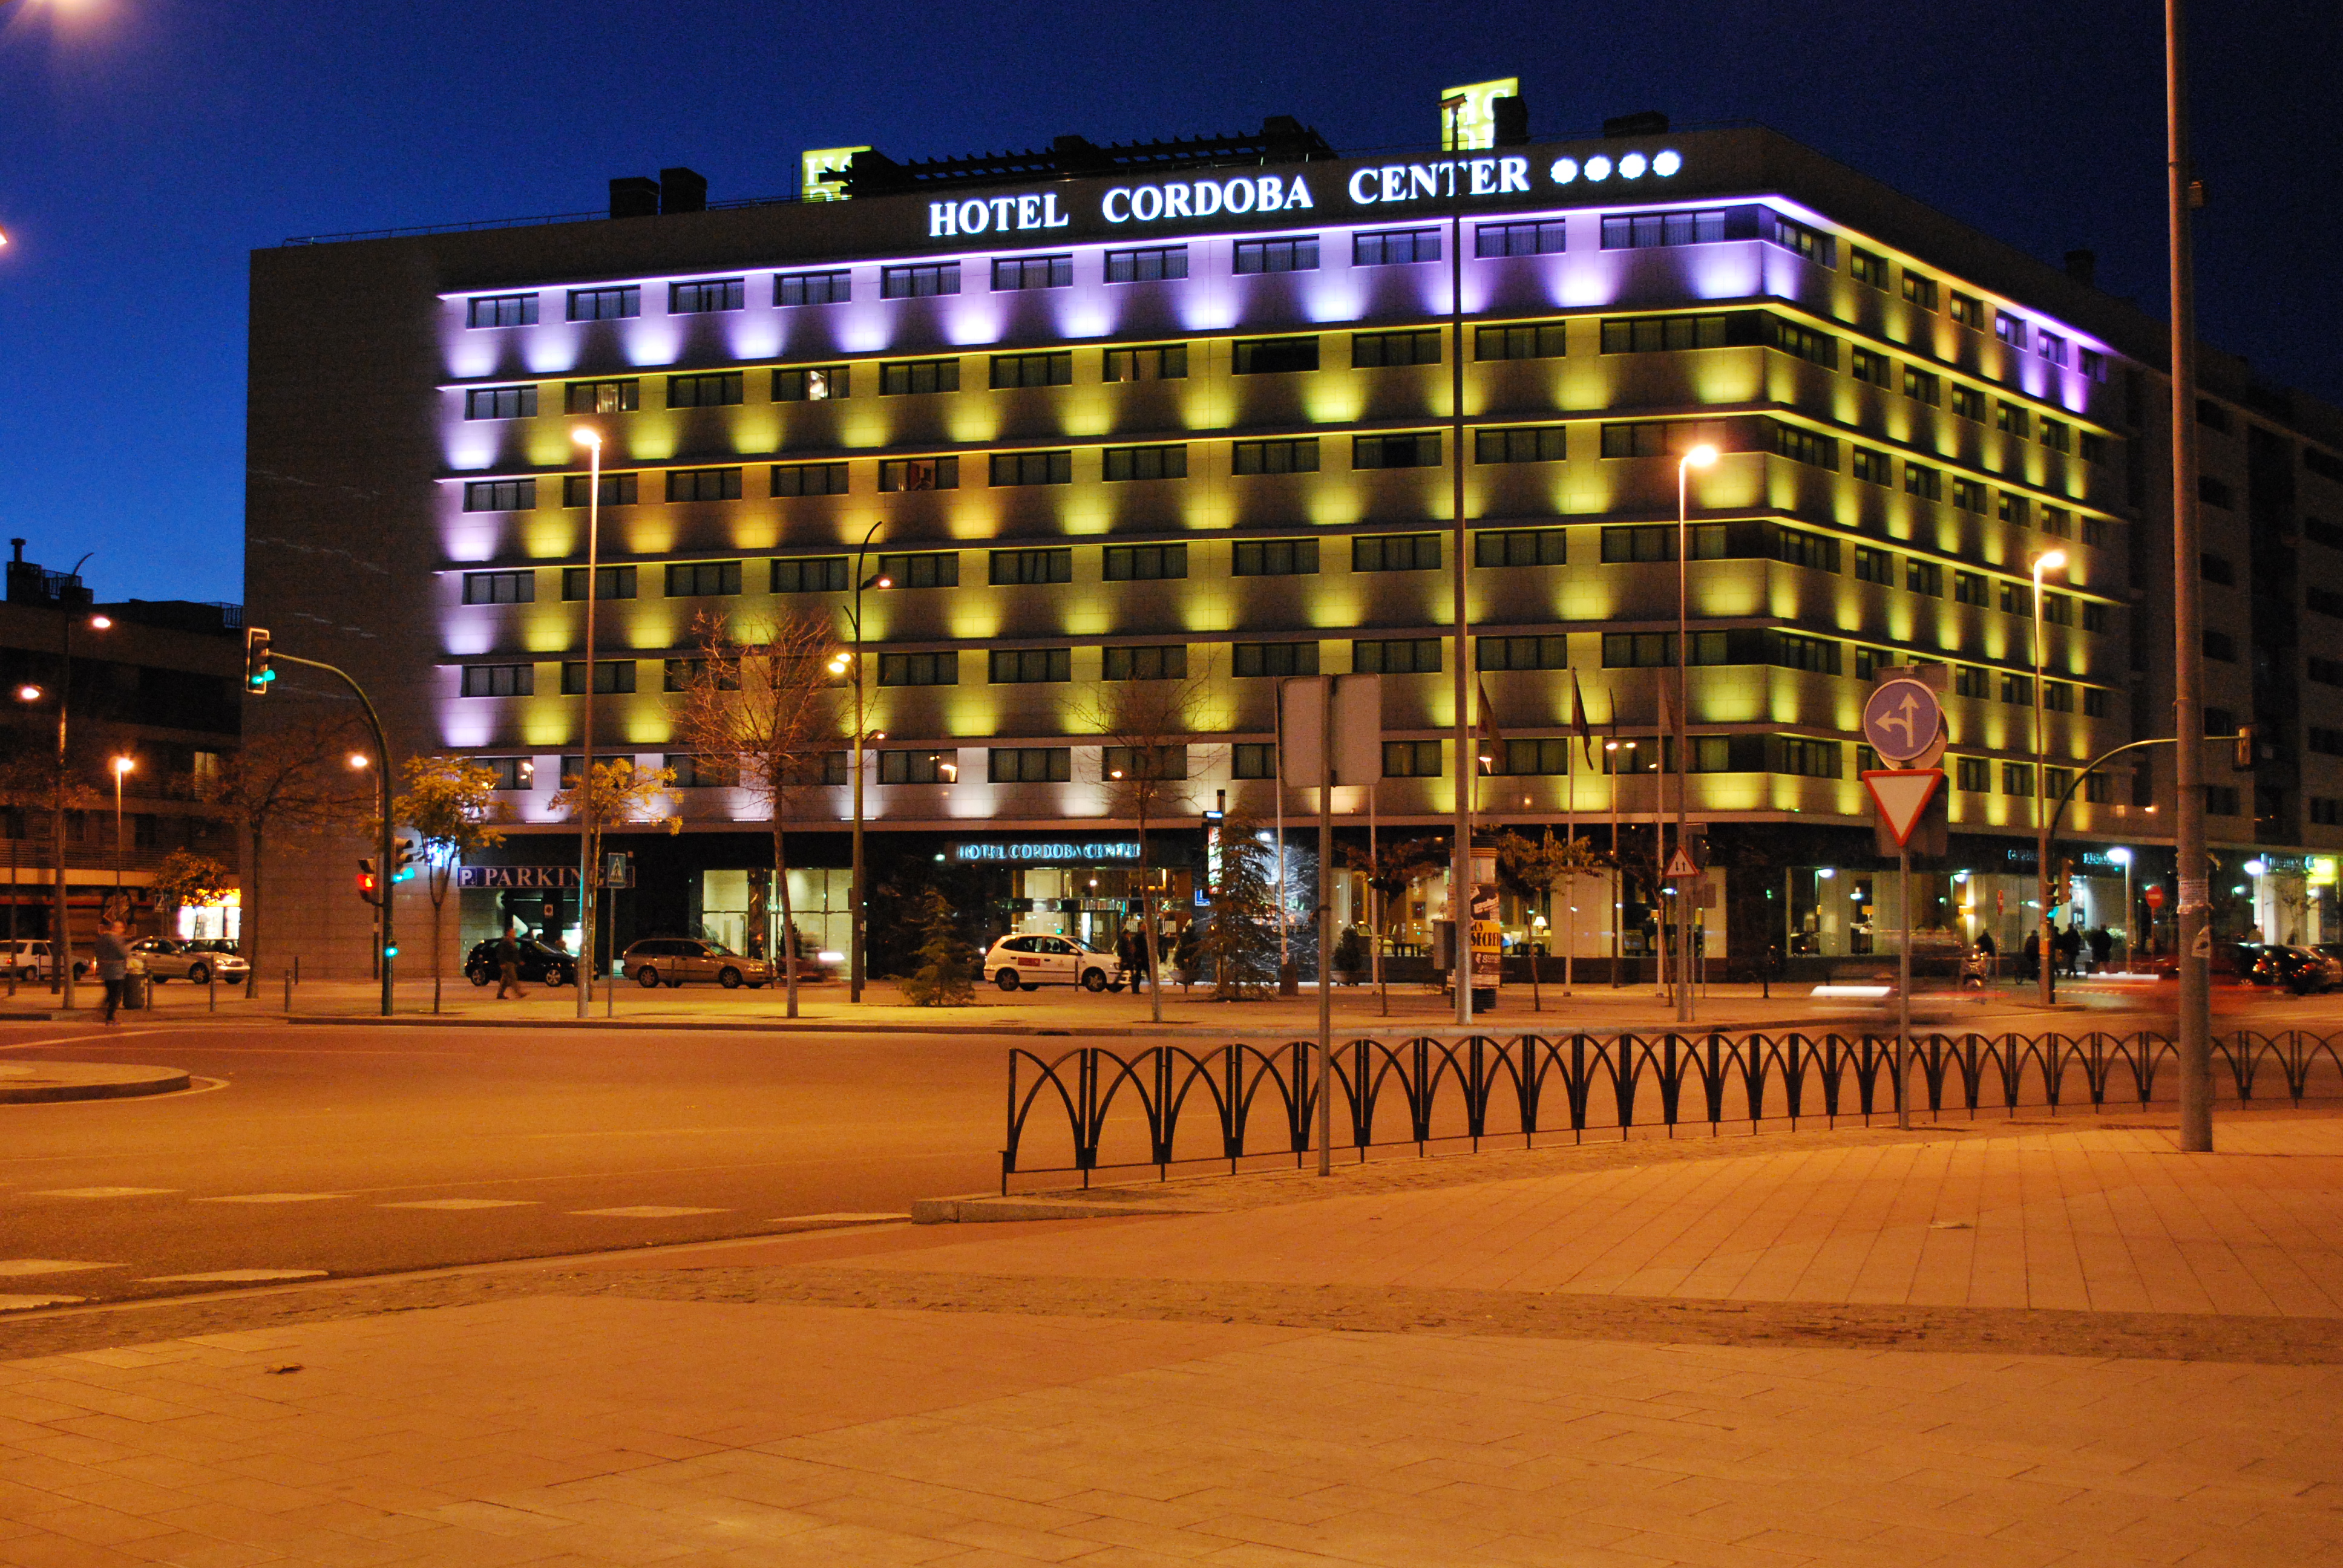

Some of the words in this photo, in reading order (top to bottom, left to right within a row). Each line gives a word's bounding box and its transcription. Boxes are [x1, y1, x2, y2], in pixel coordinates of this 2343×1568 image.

[929, 194, 1069, 237] HOTEL
[1102, 176, 1314, 223] CORDOBA
[1349, 157, 1530, 204] CENTER
[955, 844, 1008, 860] HOTEL
[1008, 843, 1082, 860] CORDOBA
